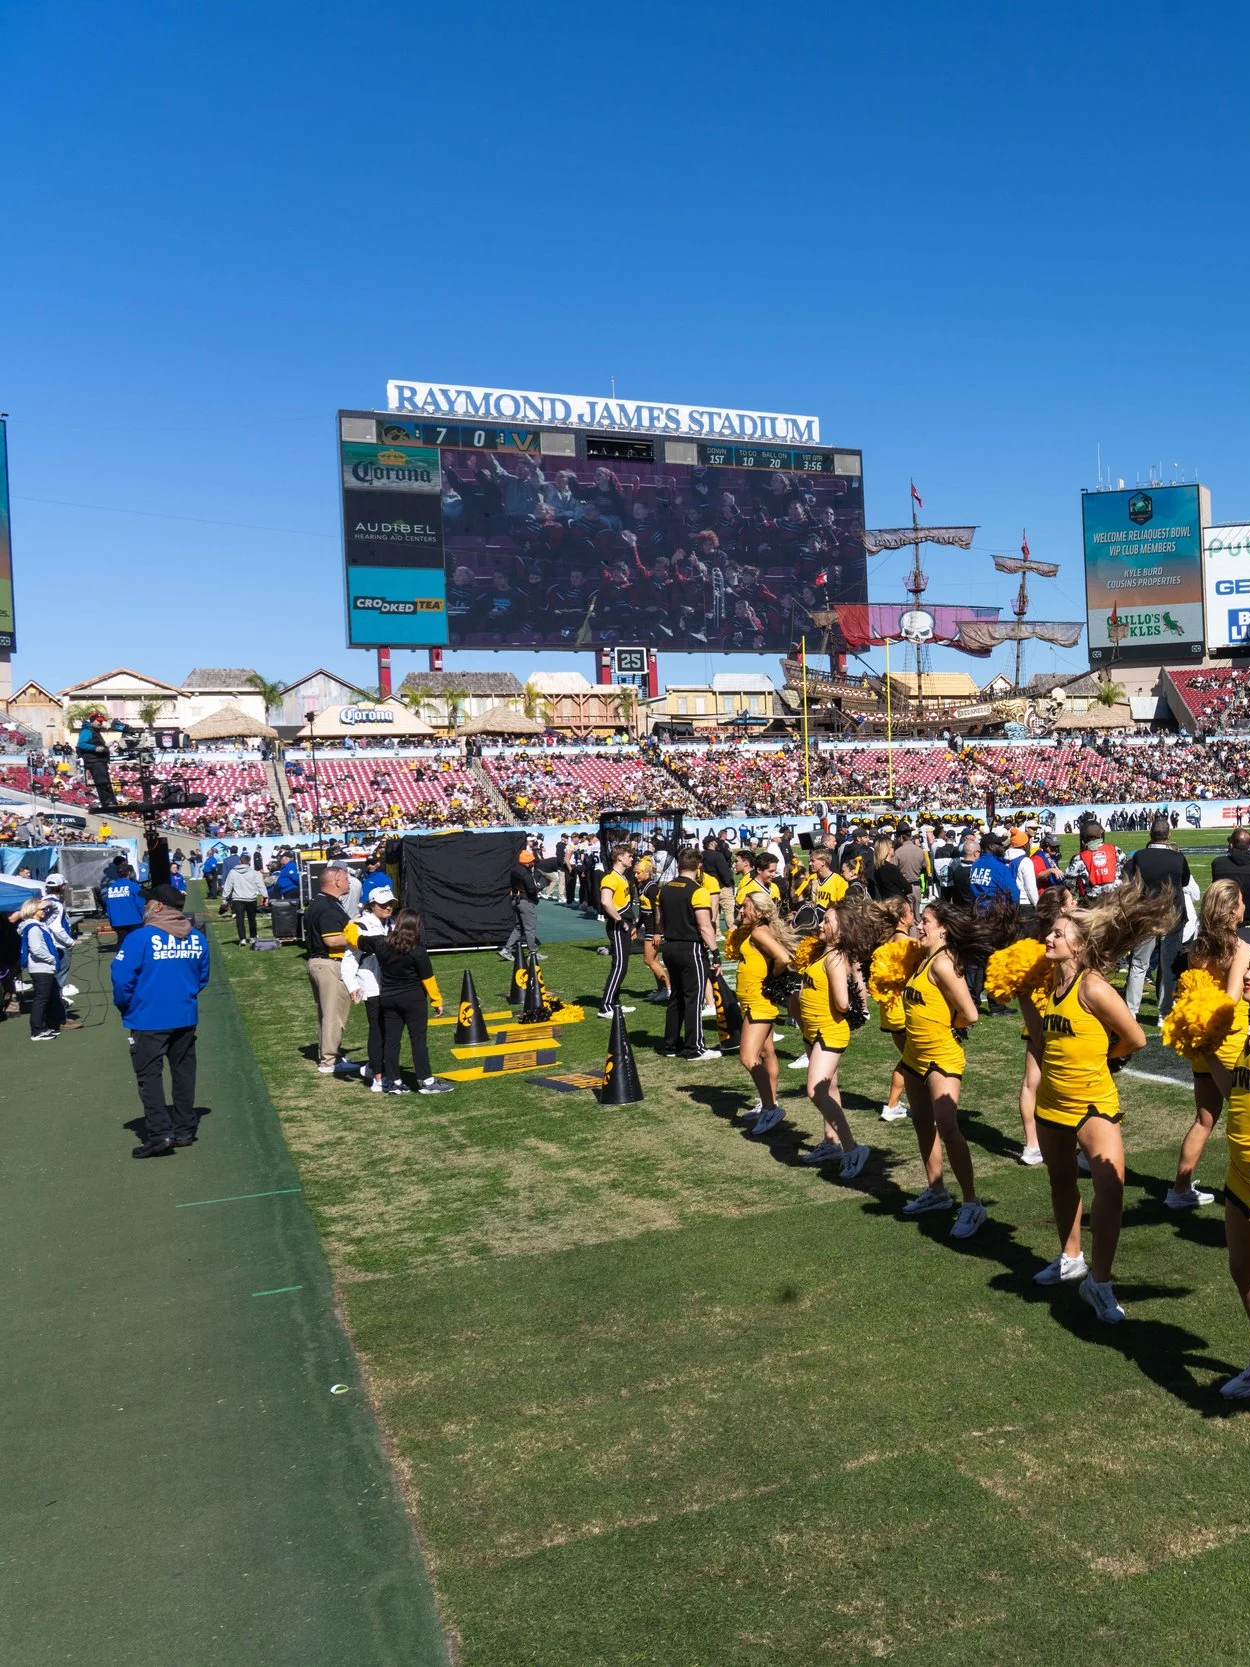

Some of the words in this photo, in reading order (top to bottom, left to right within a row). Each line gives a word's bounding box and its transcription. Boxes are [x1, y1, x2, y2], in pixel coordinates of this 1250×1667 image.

[395, 385, 572, 421] RAYMOND
[578, 401, 682, 432] JAMES
[688, 409, 816, 441] STADIUM
[436, 428, 447, 444] 7
[474, 430, 486, 447] 0
[707, 447, 727, 455] DOWN
[762, 452, 777, 460] BALL
[710, 455, 725, 464] 1ST
[743, 457, 753, 467] 10
[769, 459, 781, 469] 20
[803, 461, 822, 471] 3:56
[352, 461, 433, 485] Corona
[355, 522, 436, 534] AUDIBEL
[1093, 530, 1127, 544] WELCOME
[1128, 528, 1170, 542] RELIAQUEST
[1171, 526, 1191, 539] BOWL
[1109, 545, 1122, 556] VIP
[1122, 544, 1139, 556] CLUB
[1139, 542, 1176, 554] MEMBERS
[1124, 567, 1142, 577] KYLE
[1107, 579, 1137, 589] COUSINS
[1138, 576, 1181, 588] PROPERTIES
[356, 598, 414, 613] CROOKED
[419, 600, 441, 610] TEA
[620, 653, 642, 669] 25
[339, 706, 394, 726] Corona
[153, 950, 203, 960] SECURITY
[1042, 1014, 1076, 1037] OWA
